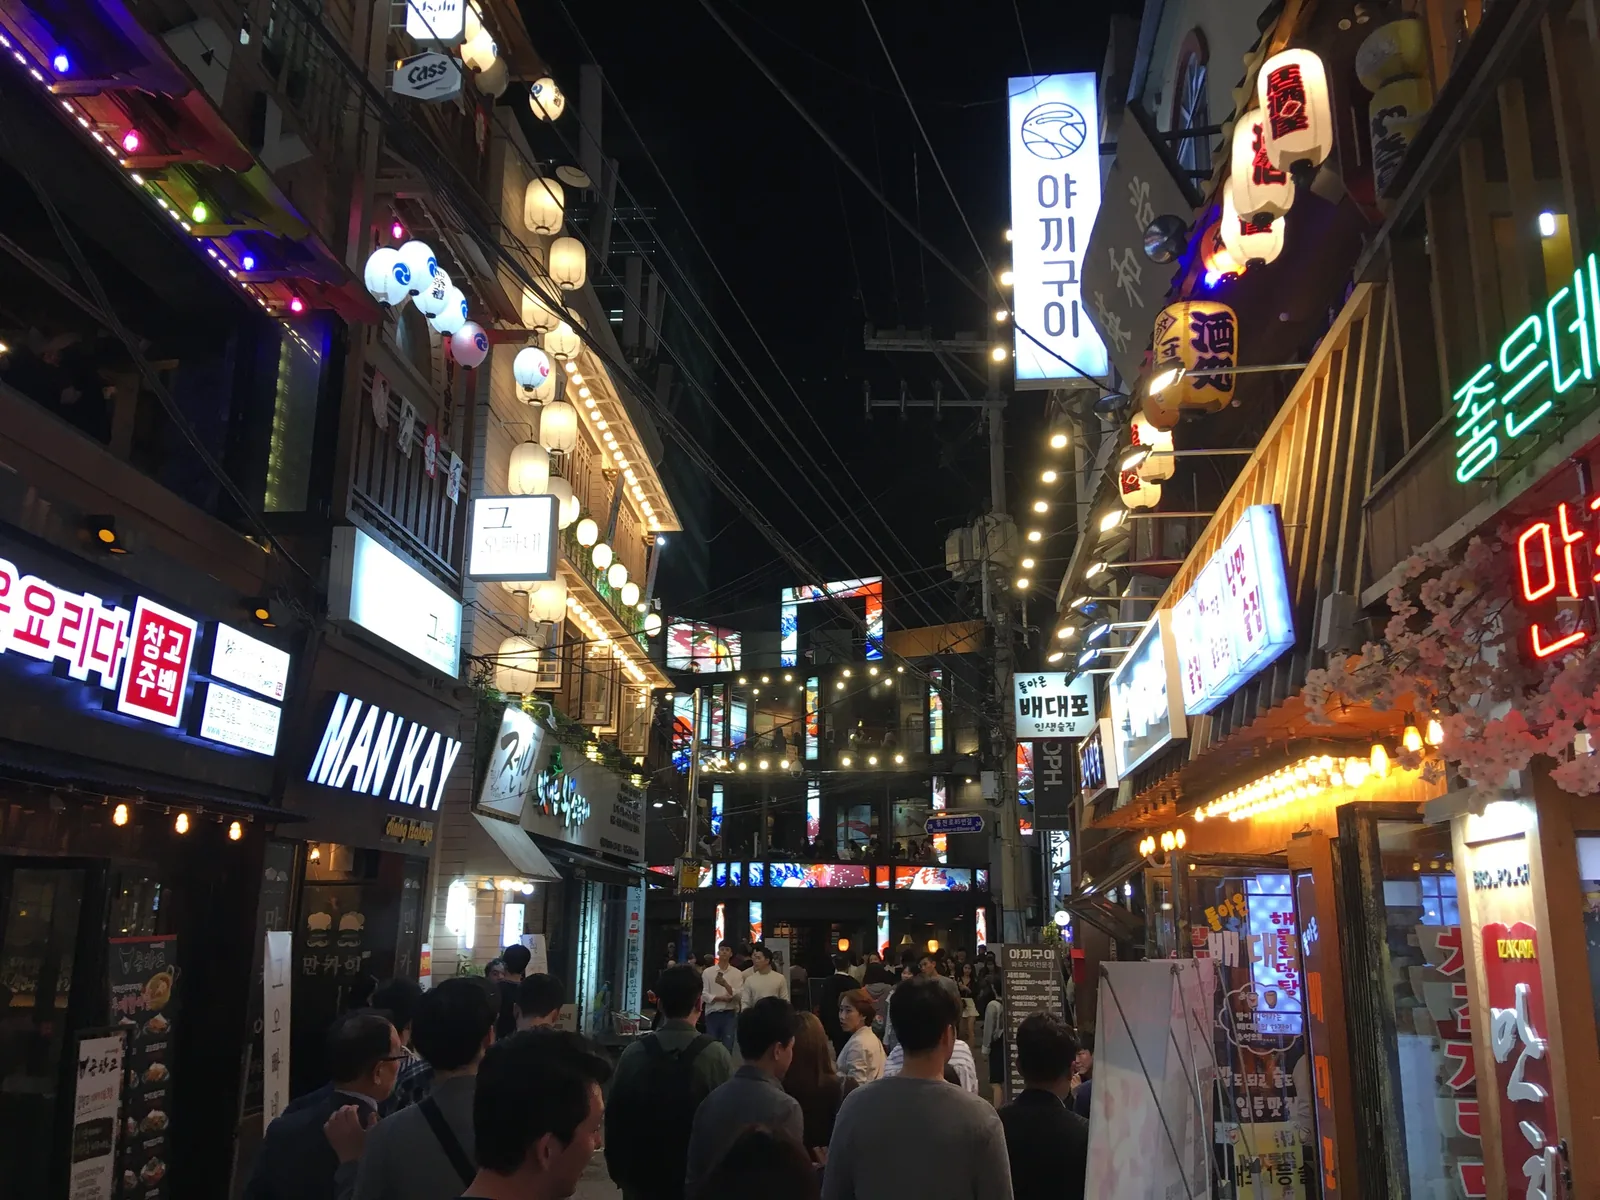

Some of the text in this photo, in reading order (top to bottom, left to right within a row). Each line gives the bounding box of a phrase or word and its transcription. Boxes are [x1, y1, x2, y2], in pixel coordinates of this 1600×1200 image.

[1037, 172, 1081, 338] 야끼구이
[1517, 497, 1600, 659] 만
[1243, 584, 1263, 644] 술집
[143, 621, 184, 664] 창고
[136, 660, 178, 707] 주백
[1018, 675, 1048, 695] 돌아온
[1018, 694, 1090, 719] 배대포
[1034, 721, 1076, 733] 인생술집
[307, 692, 404, 797] MAN
[389, 721, 462, 812] KAY
[1204, 893, 1248, 932] 돌아온
[1009, 948, 1055, 960] 야끼구이
[1497, 939, 1536, 959] IZAKAYA
